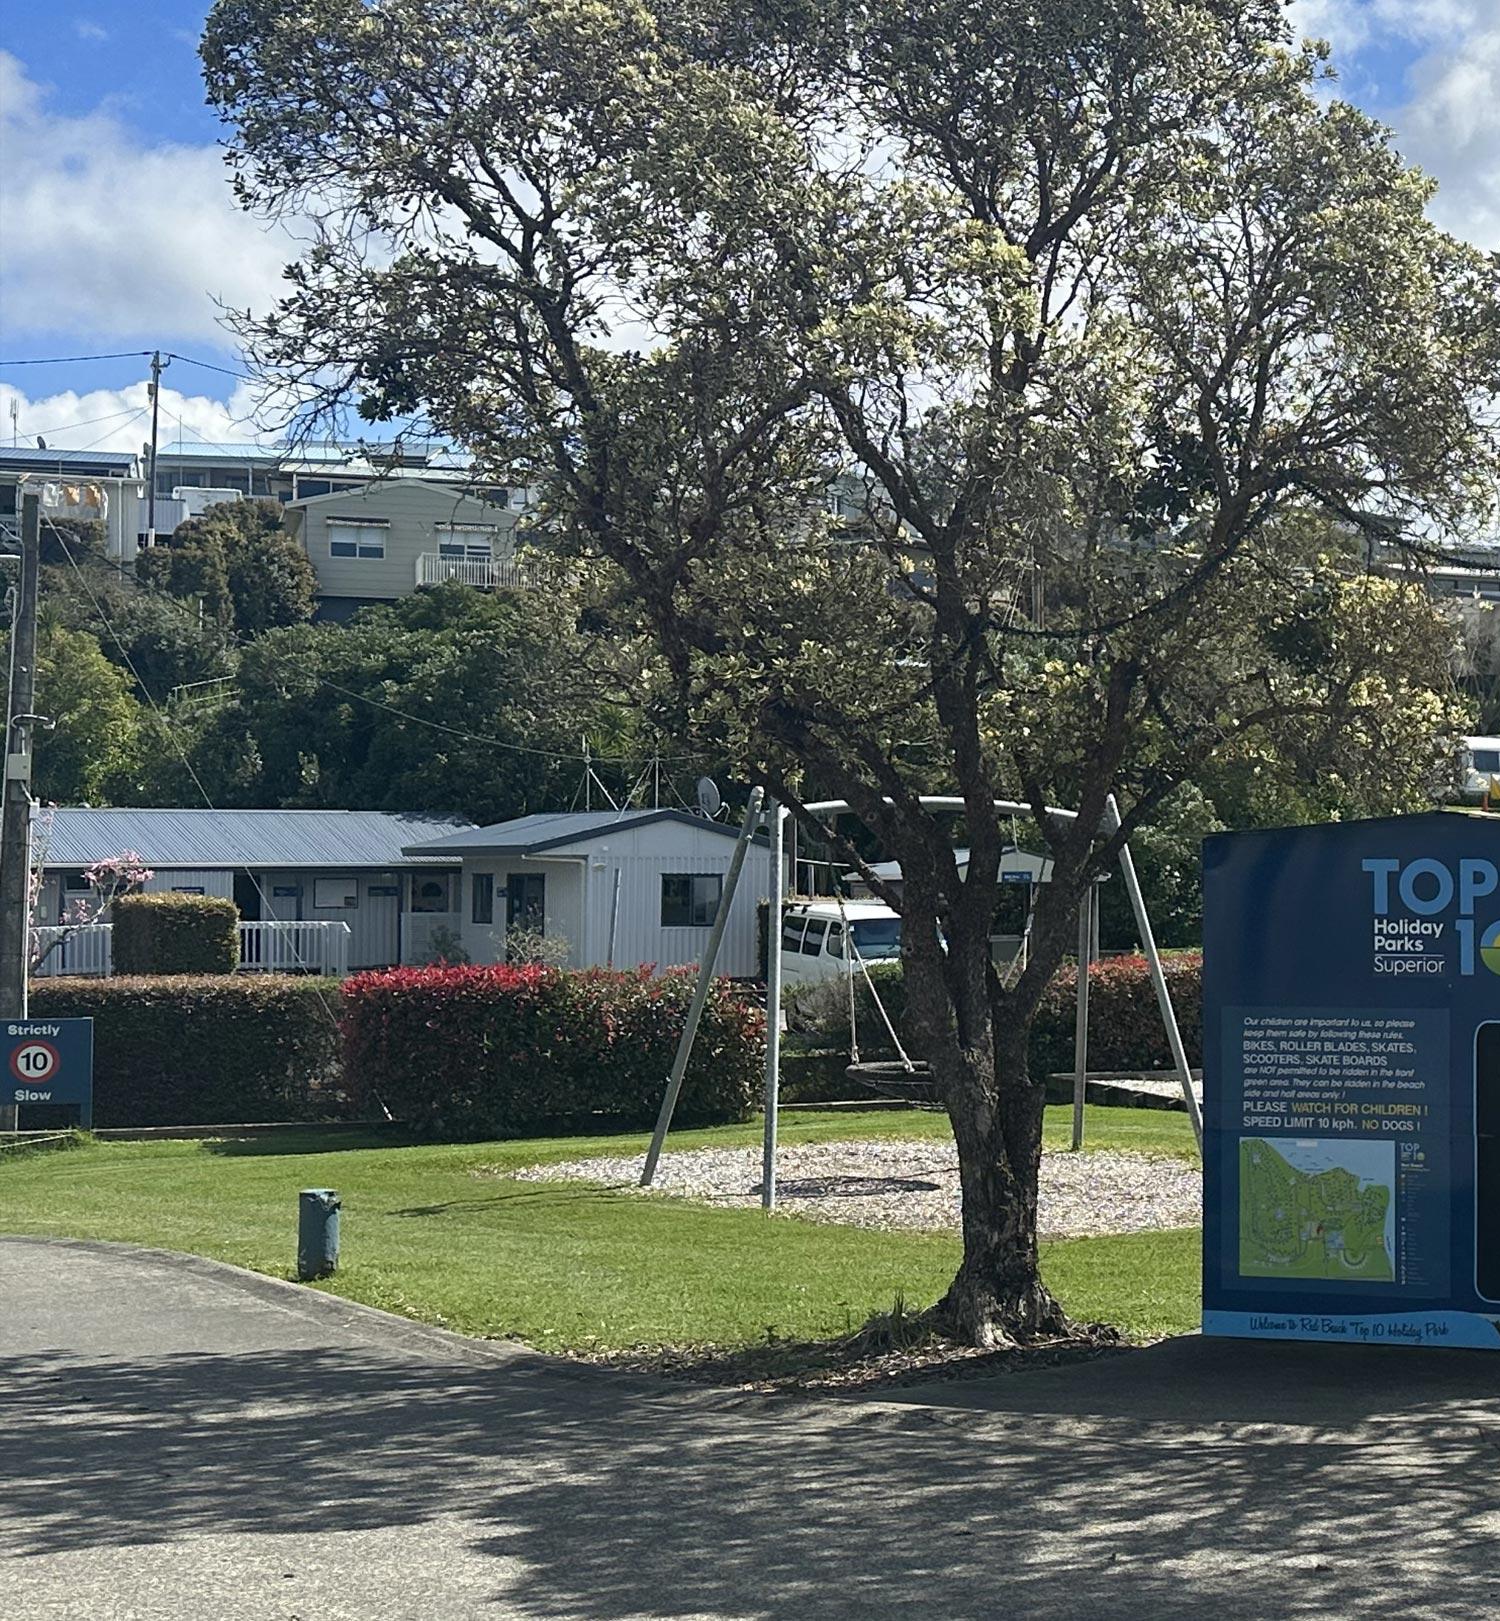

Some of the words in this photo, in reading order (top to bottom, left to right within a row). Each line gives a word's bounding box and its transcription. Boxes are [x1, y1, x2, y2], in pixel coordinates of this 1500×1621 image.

[1362, 858, 1498, 915] TOP
[1374, 919, 1444, 938] Holiday
[1374, 936, 1424, 951] Parks
[1374, 957, 1445, 976] Superior
[1244, 1017, 1258, 1026] Our
[1260, 1017, 1292, 1026] children
[1310, 1018, 1350, 1028] important
[1385, 1019, 1415, 1028] please
[8, 1024, 60, 1036] Strictly
[1243, 1029, 1265, 1038] keep
[1266, 1029, 1287, 1037] them
[1289, 1030, 1306, 1038] safe
[1308, 1030, 1319, 1039] by
[1321, 1030, 1356, 1039] following
[1280, 1041, 1321, 1051] ROLLER
[21, 1052, 48, 1071] 10
[1306, 1055, 1340, 1065] SKATE
[1343, 1056, 1388, 1066] BOARDS
[1259, 1066, 1276, 1074] NOT
[1277, 1067, 1317, 1077] permitted
[1329, 1067, 1341, 1075] be
[1380, 1068, 1394, 1076] the
[1243, 1079, 1268, 1087] green
[1293, 1078, 1311, 1087] They
[1331, 1079, 1342, 1087] be
[1382, 1080, 1395, 1088] the
[1397, 1081, 1425, 1089] beach
[14, 1090, 52, 1101] Slow
[1263, 1090, 1280, 1098] and
[1243, 1101, 1287, 1113] PLEASE
[1291, 1103, 1330, 1114] WATCH
[1335, 1104, 1358, 1114] FOR
[1361, 1104, 1421, 1116] CHILDREN
[1243, 1116, 1281, 1128] SPEED
[1284, 1117, 1314, 1128] LIMIT
[1318, 1118, 1329, 1128] 10
[1332, 1118, 1357, 1131] kph.
[1362, 1119, 1378, 1130] NO
[1382, 1120, 1413, 1131] DOGS
[1373, 1323, 1384, 1337] 10
[1426, 1322, 1449, 1336] Park
